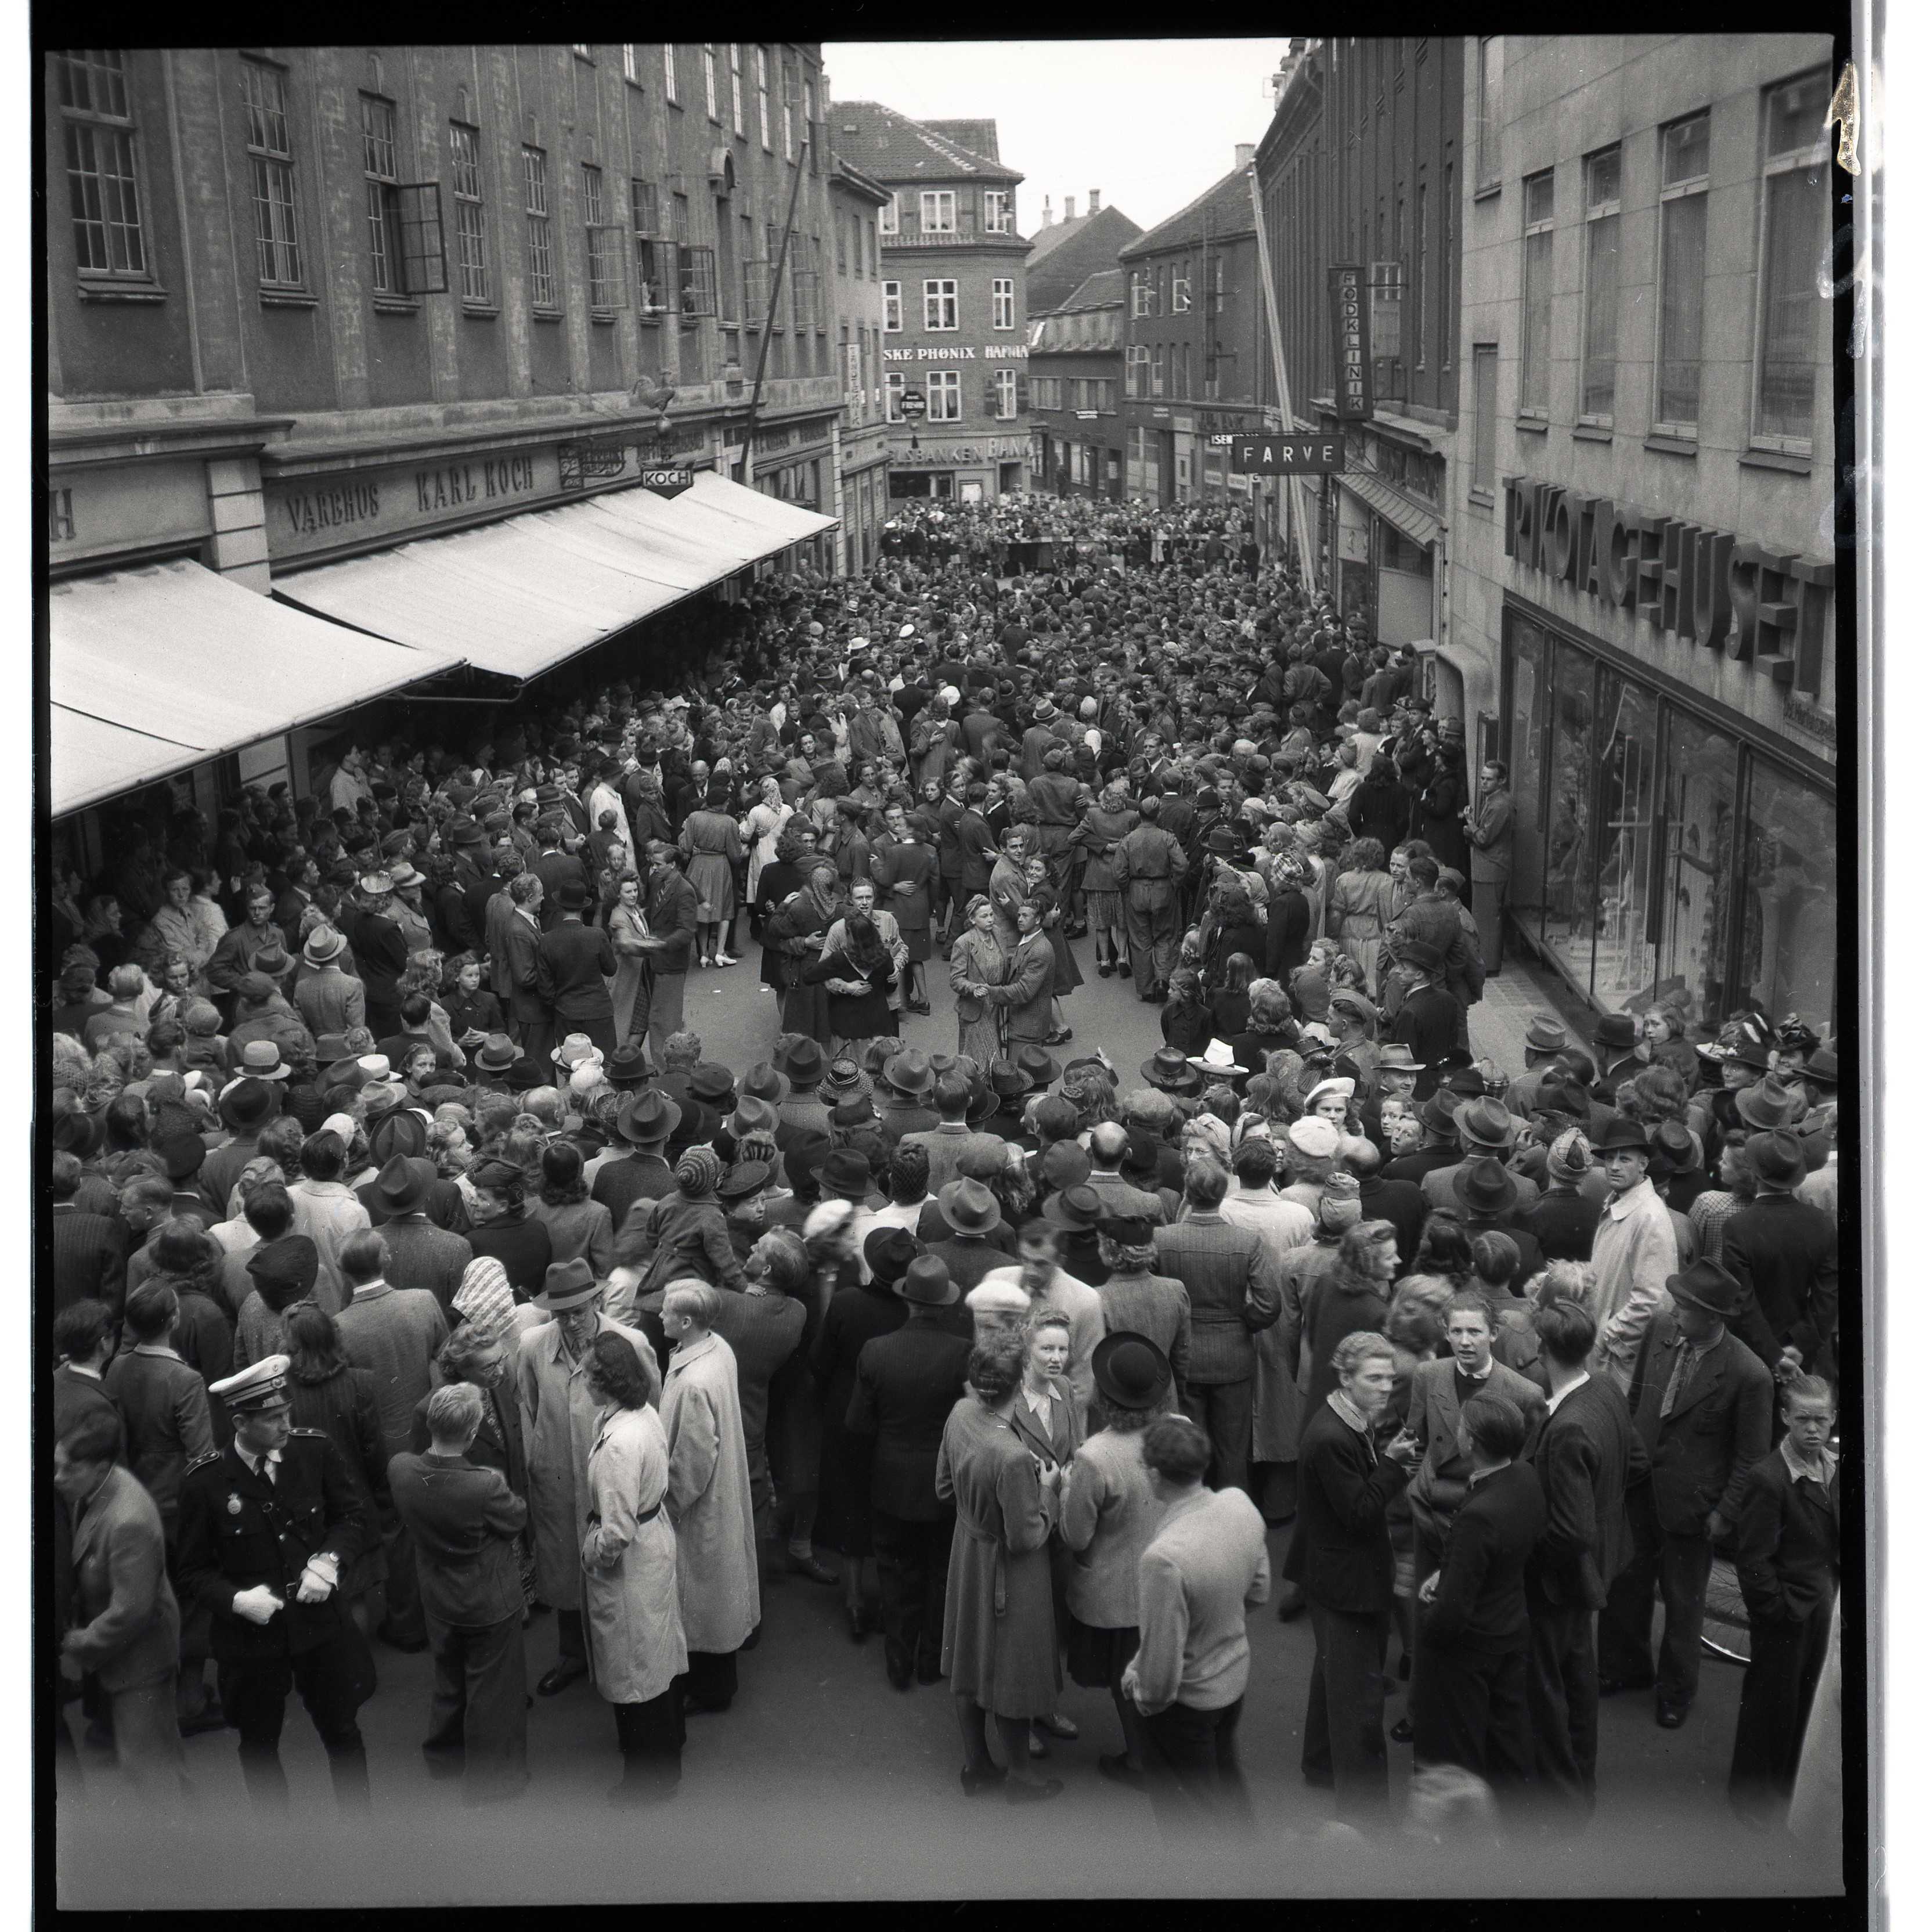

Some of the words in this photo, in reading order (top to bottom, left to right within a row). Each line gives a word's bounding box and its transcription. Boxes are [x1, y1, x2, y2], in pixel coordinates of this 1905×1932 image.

[883, 349, 913, 360] SKE
[917, 347, 975, 360] PHØNIX
[1343, 273, 1362, 410] FODKLINIK
[645, 472, 689, 485] KOCH
[1243, 445, 1334, 463] FARVE
[416, 465, 476, 512] KARL
[484, 455, 534, 498] KOCH
[286, 484, 380, 534] VAREHUS
[1503, 475, 1835, 694] TRIKOTAGEHUSET
